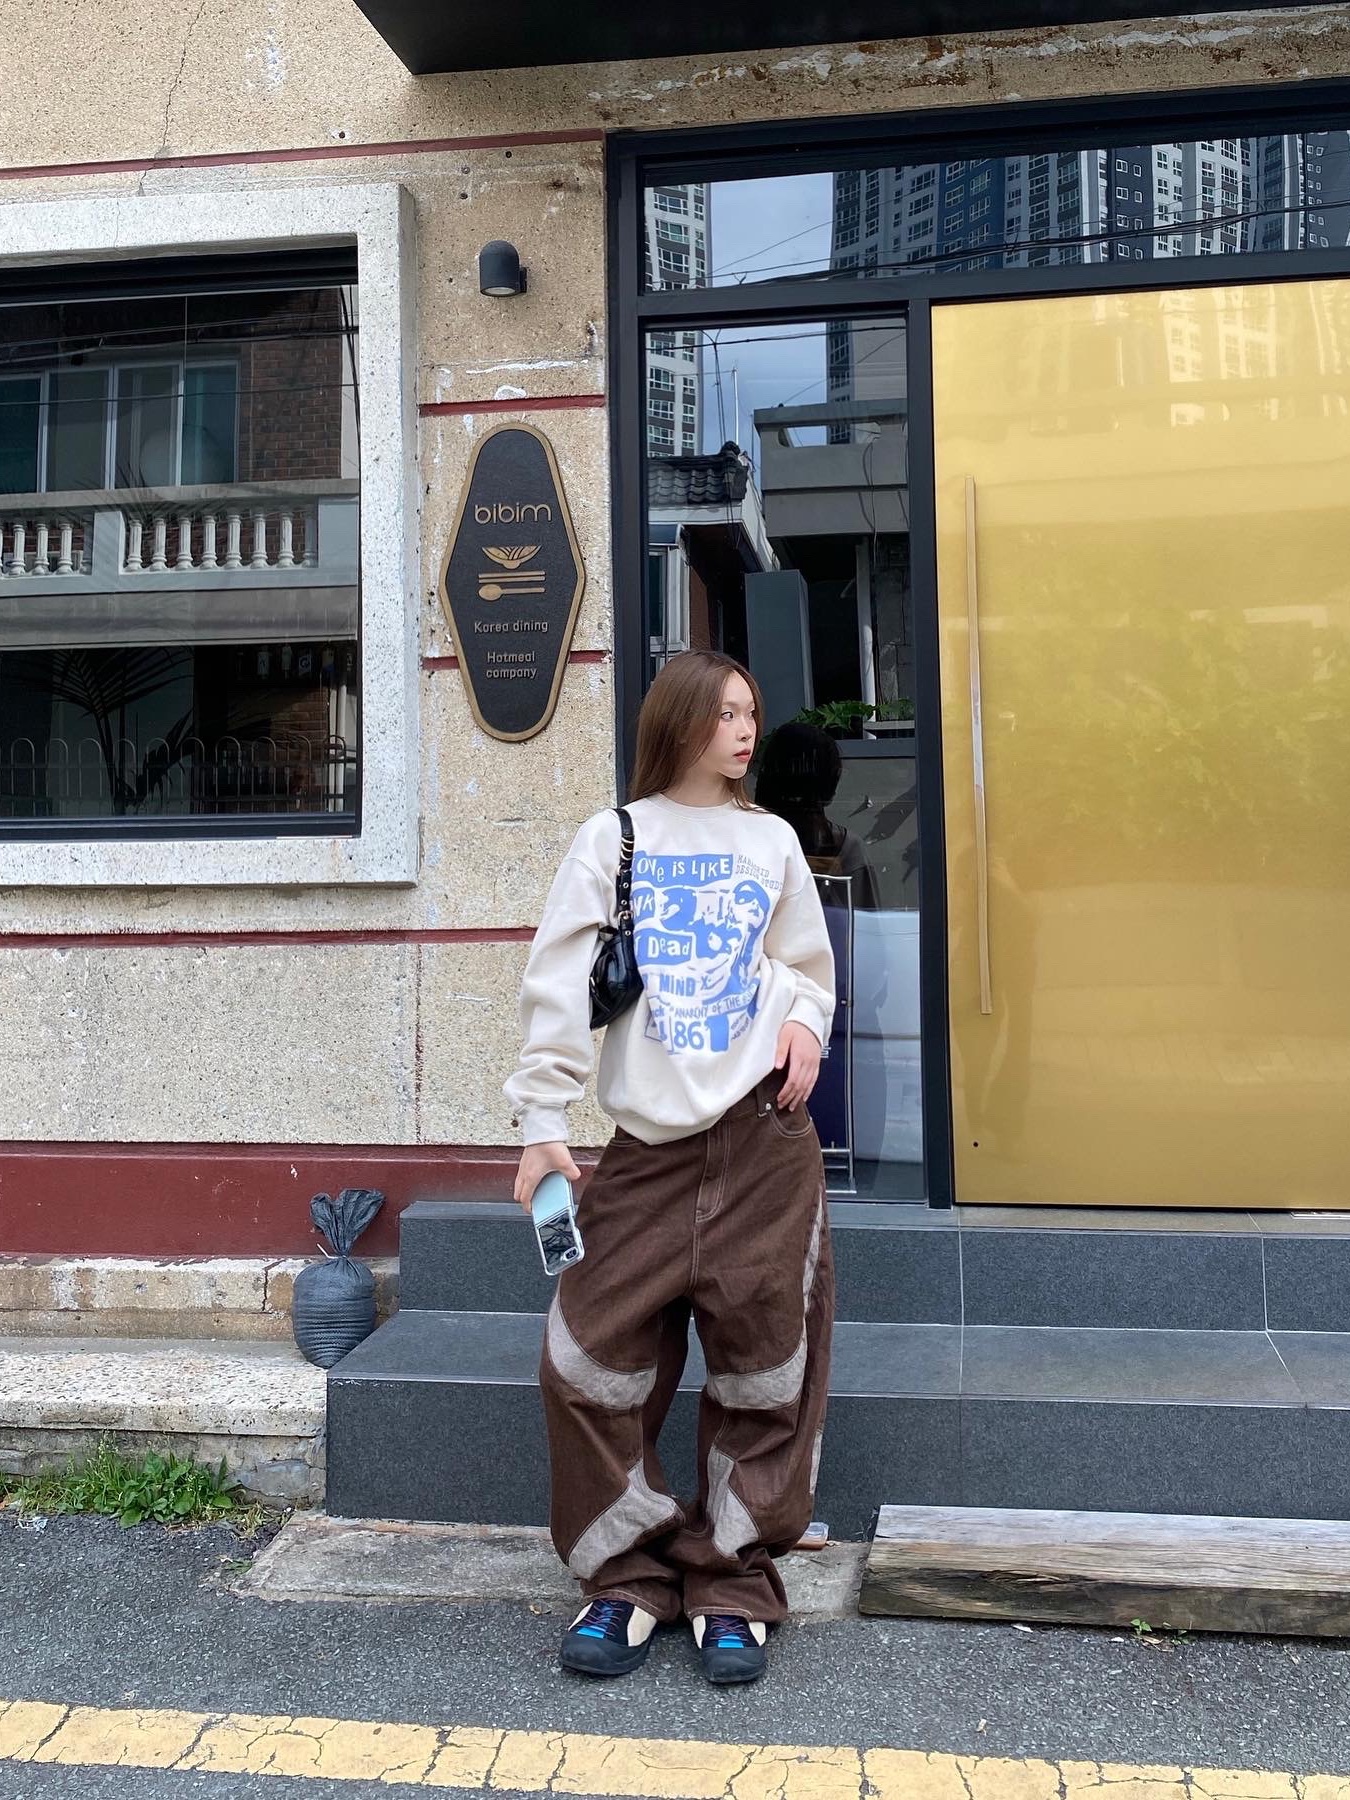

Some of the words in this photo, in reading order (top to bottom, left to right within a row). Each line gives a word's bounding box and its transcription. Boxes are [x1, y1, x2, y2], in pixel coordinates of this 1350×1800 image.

[475, 503, 552, 525] bibim
[474, 621, 509, 634] Korea
[513, 619, 548, 633] dining
[487, 650, 535, 663] Hotmeal
[486, 668, 537, 680] company
[632, 857, 665, 883] OVe
[691, 858, 731, 881] LIKE
[647, 936, 690, 959] Dead
[723, 996, 741, 1010] THE
